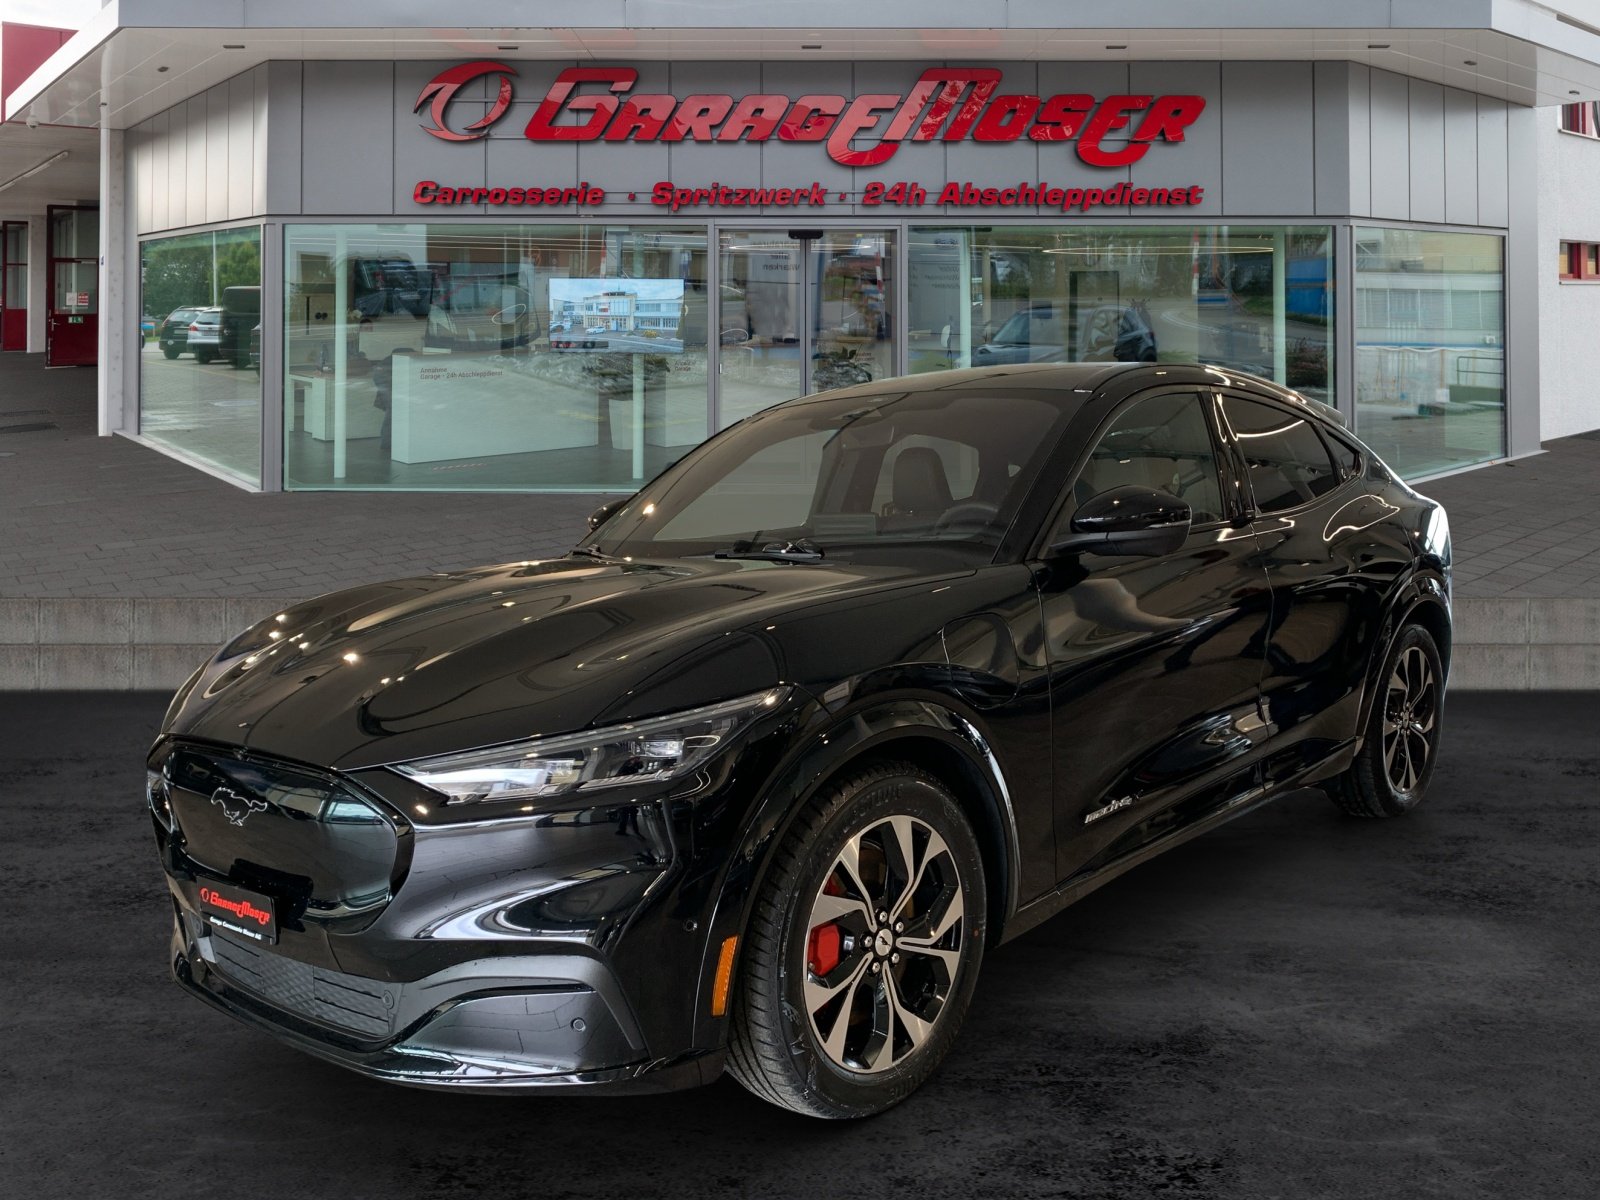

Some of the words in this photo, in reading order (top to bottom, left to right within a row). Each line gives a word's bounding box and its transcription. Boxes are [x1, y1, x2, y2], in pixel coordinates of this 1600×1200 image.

[413, 181, 605, 206] Carrosserie
[651, 181, 826, 212] Spritzwerk
[862, 181, 927, 206] 24h
[936, 181, 1204, 212] Abschleppdienst
